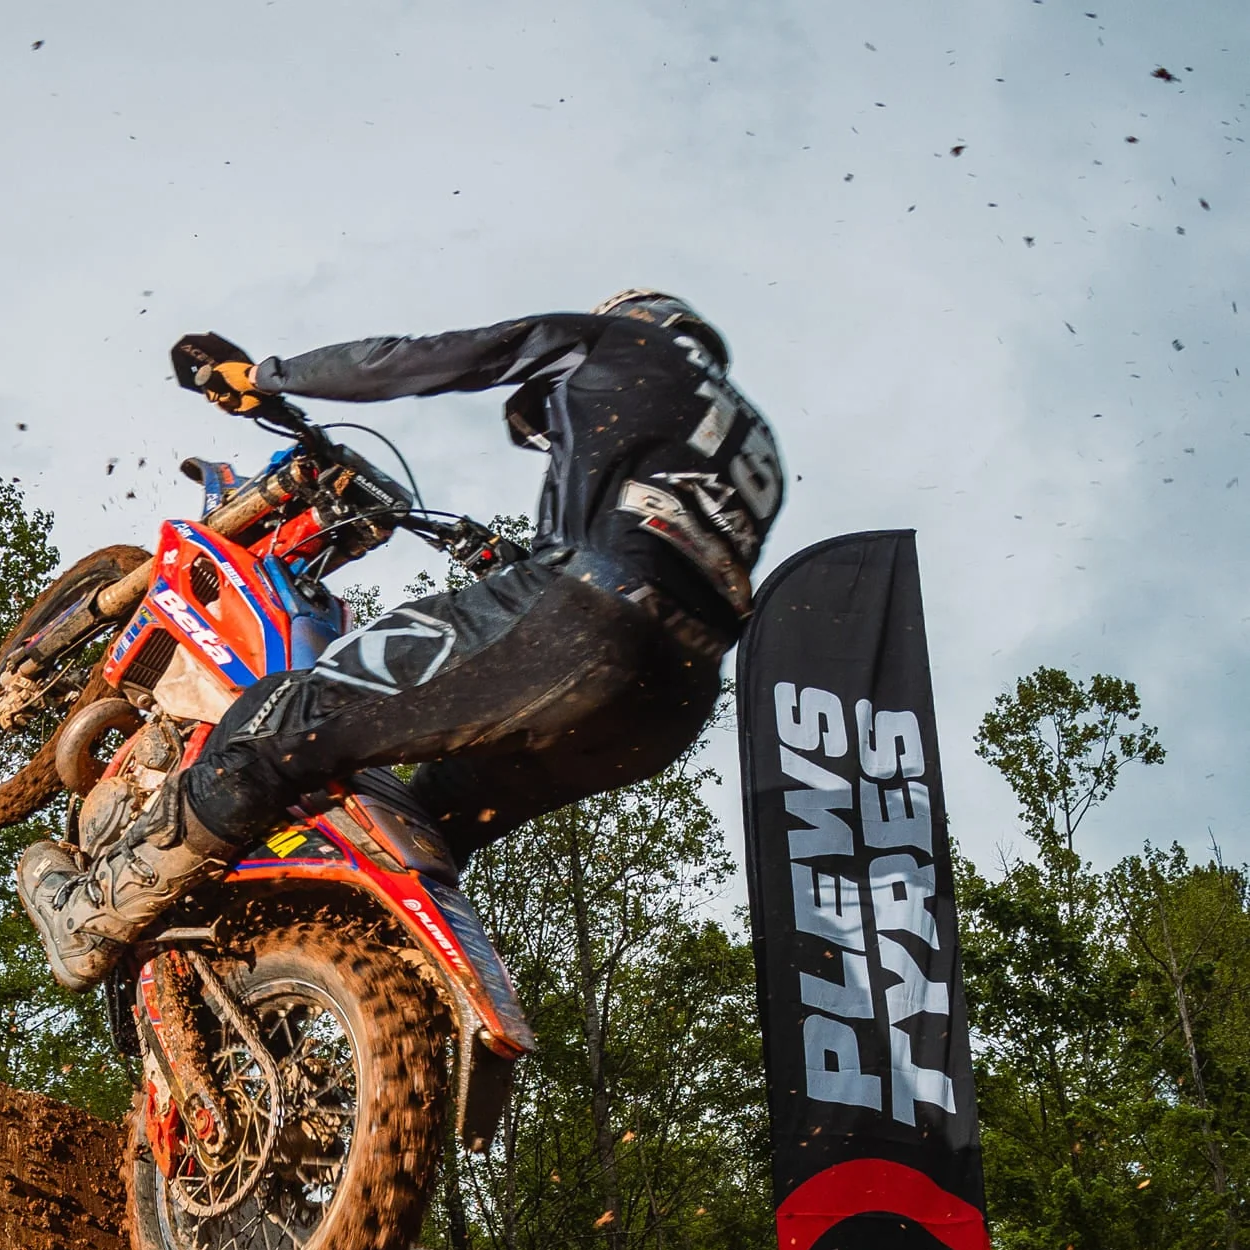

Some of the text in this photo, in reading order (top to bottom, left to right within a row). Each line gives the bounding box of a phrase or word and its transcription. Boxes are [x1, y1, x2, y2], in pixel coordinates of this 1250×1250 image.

[153, 589, 232, 665] Beta
[774, 681, 882, 1112] PLEWS
[855, 698, 956, 1127] TYRES
